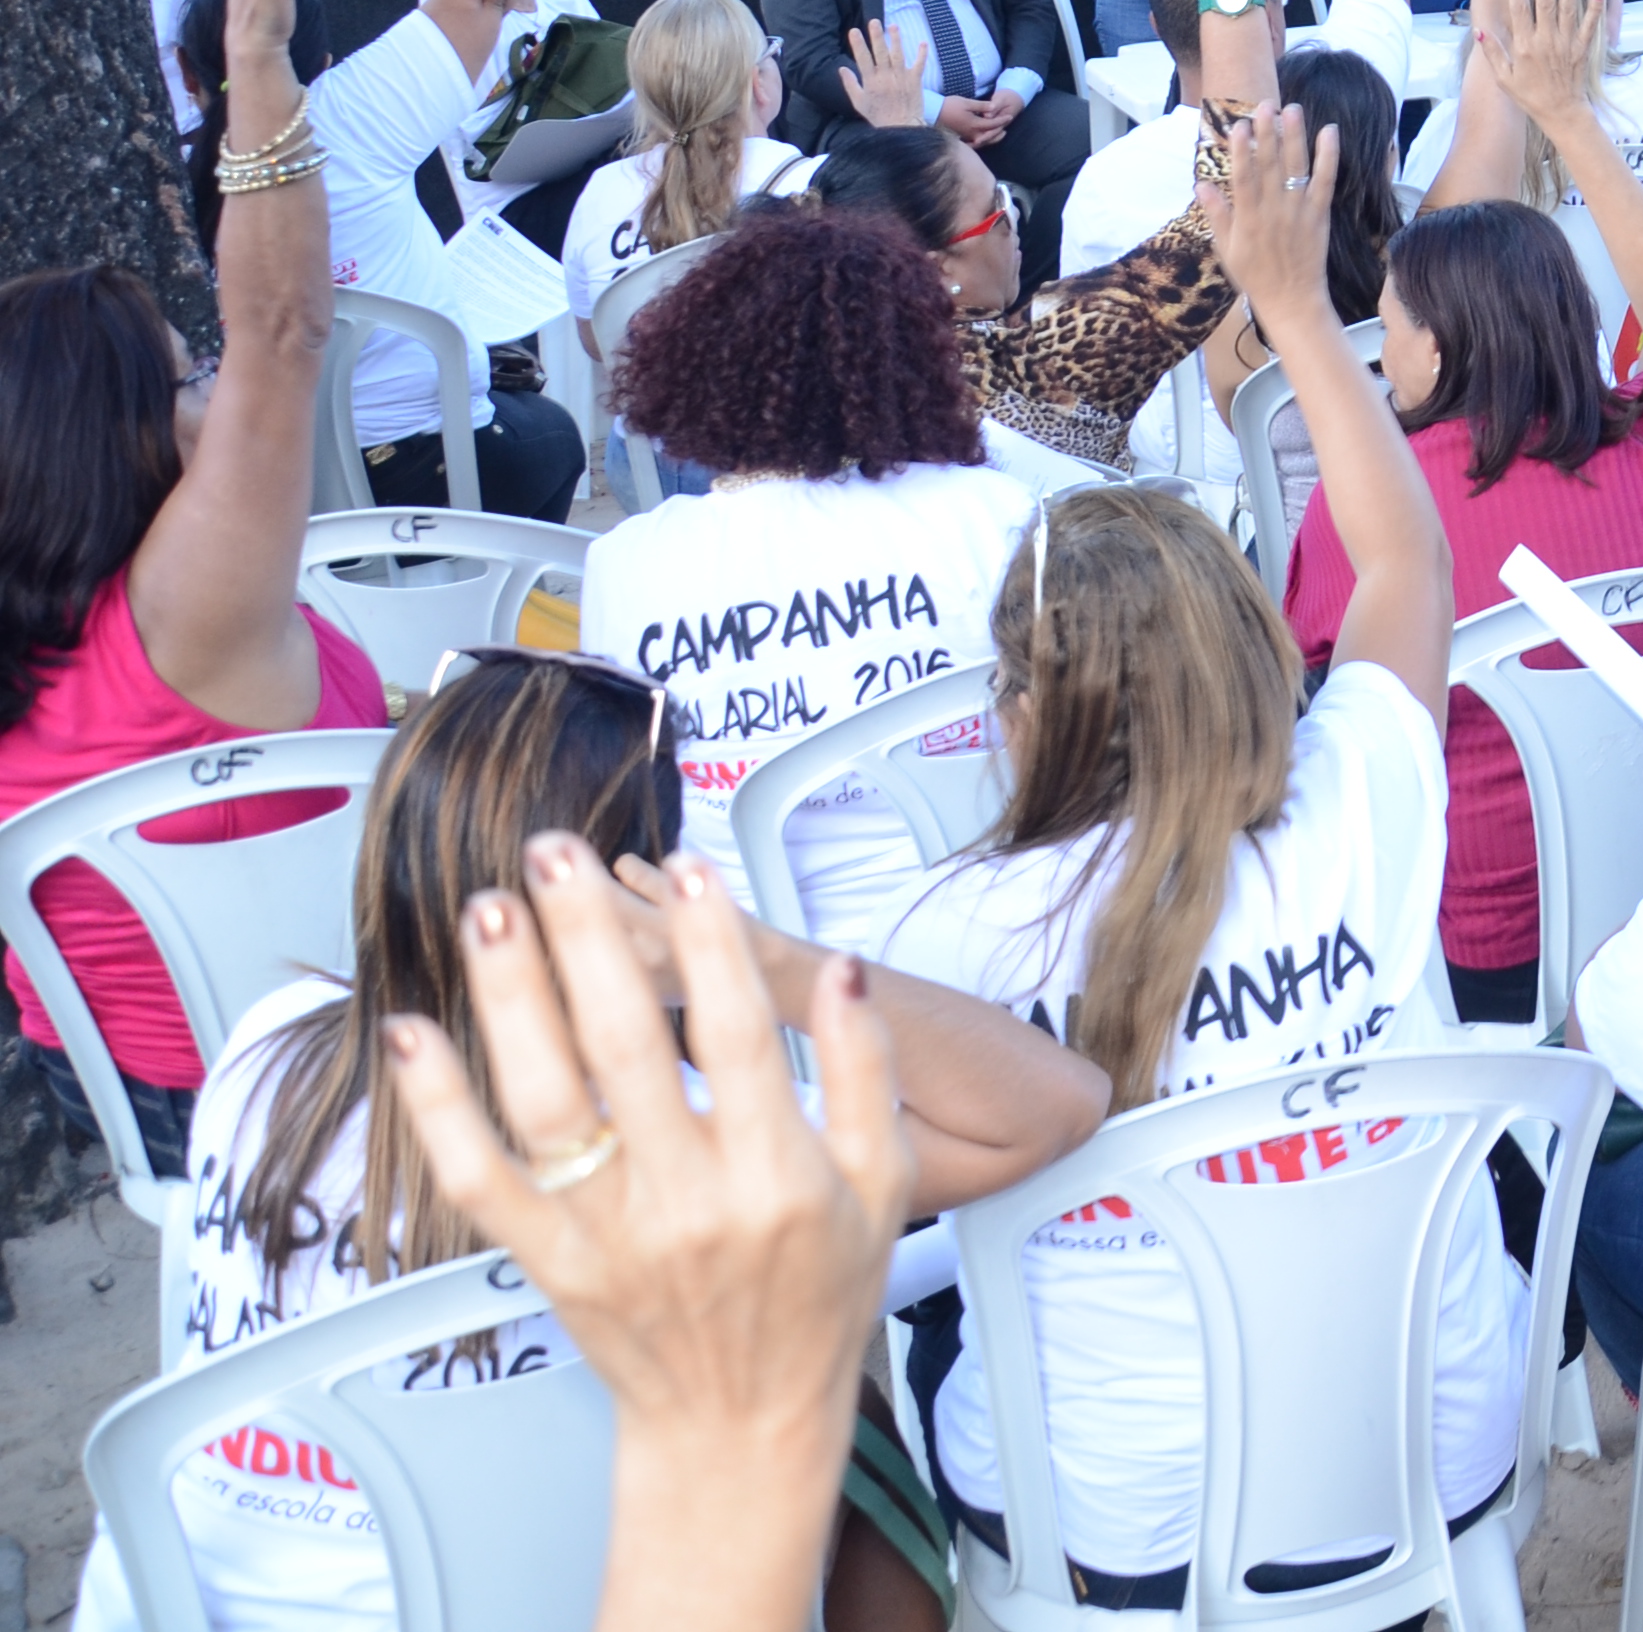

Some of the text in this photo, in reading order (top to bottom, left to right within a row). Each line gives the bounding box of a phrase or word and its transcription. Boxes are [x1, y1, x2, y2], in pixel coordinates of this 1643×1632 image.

[391, 514, 438, 542] CF
[637, 572, 938, 683] CAMPANHA
[1281, 1064, 1368, 1119] CF
[236, 1488, 336, 1526] escola
